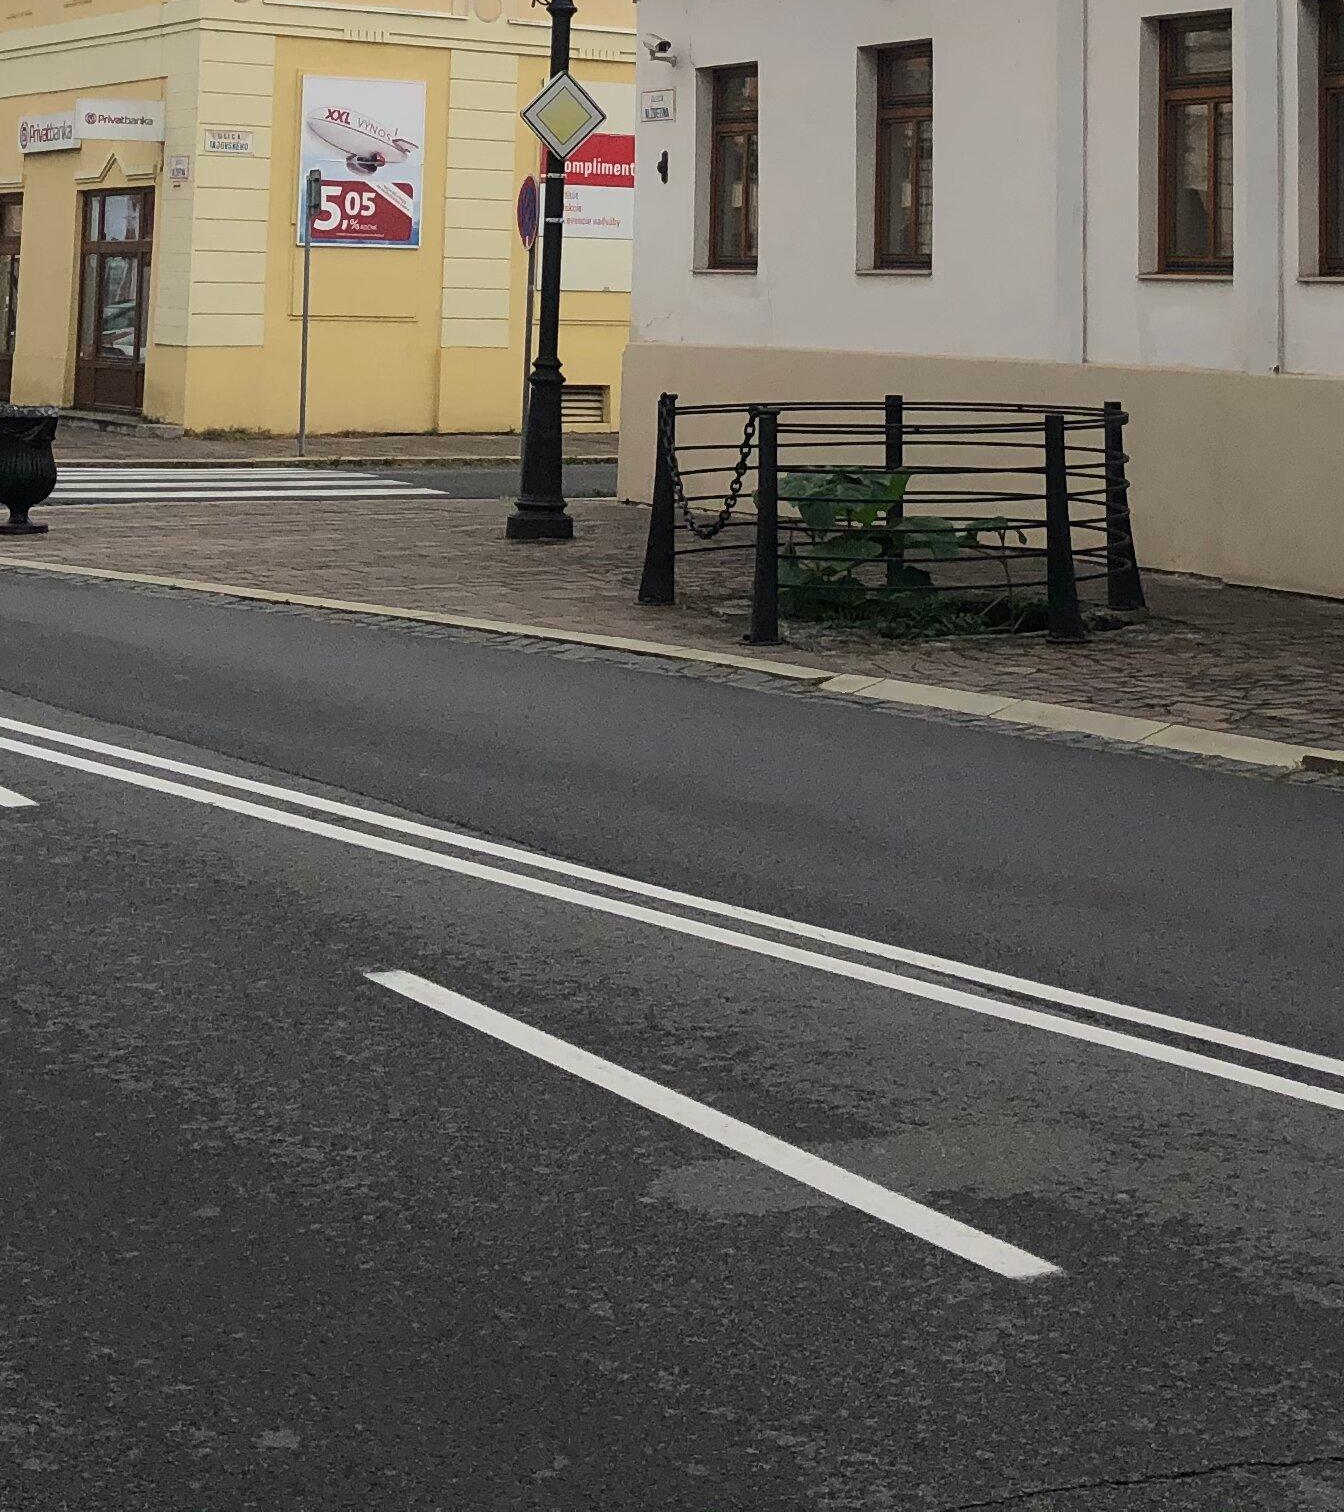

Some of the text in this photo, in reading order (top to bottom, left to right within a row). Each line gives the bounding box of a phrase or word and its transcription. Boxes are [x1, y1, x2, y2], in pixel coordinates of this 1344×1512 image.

[97, 113, 154, 126] Privatbanka
[325, 108, 351, 125] XXL
[29, 120, 73, 143] Privatbanka
[564, 157, 635, 178] ompliment
